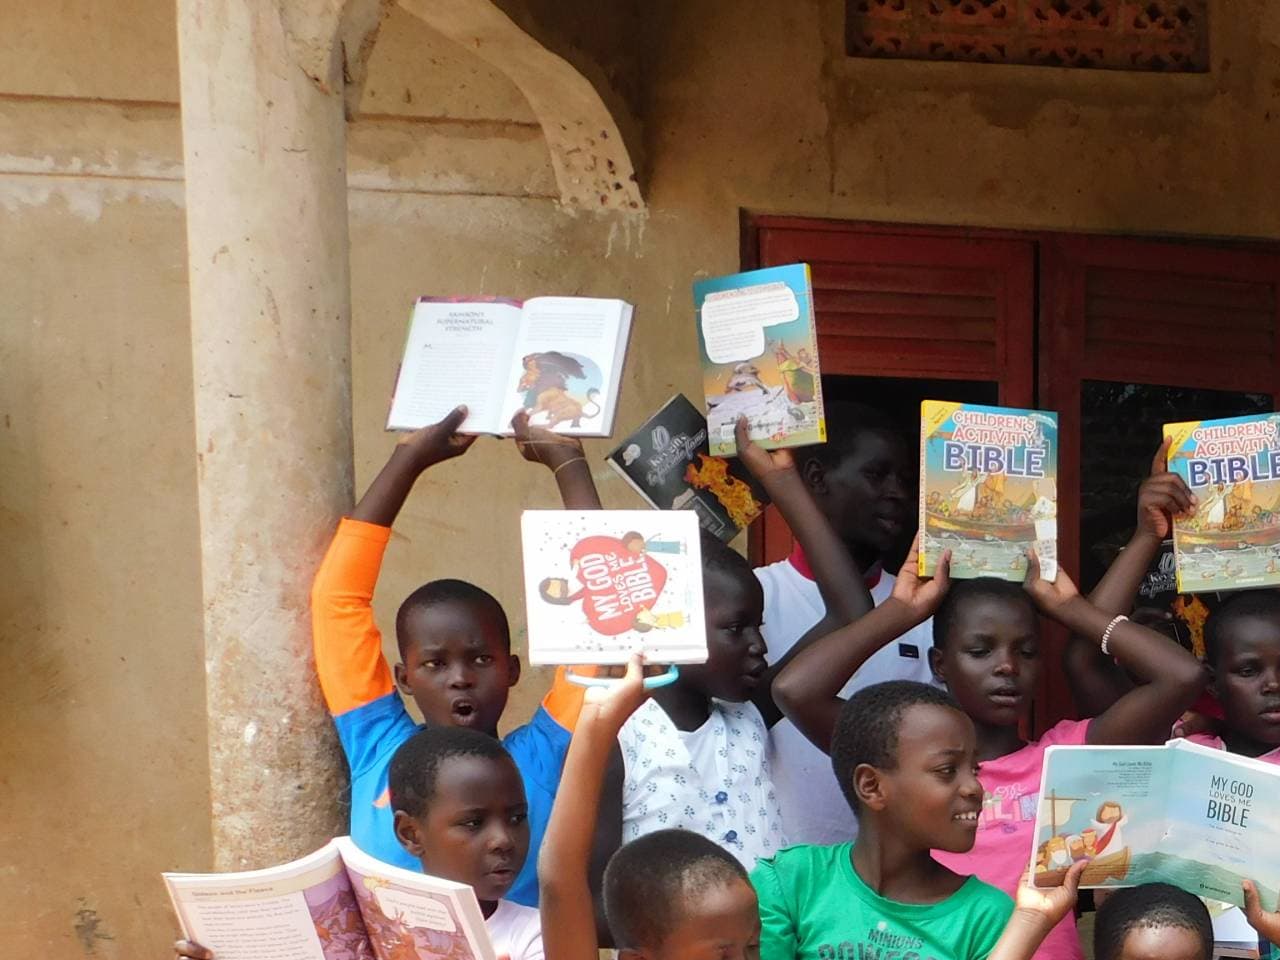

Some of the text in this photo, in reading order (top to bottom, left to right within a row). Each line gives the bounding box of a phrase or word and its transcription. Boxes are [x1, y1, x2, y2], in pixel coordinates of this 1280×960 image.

[952, 410, 1036, 432] CHILDREN'S
[1192, 421, 1276, 442] CHILDREN'S
[952, 425, 1034, 447] ACTIVITY
[1194, 434, 1276, 459] ACTIVITY
[944, 441, 1046, 478] BIBLE
[580, 553, 623, 621] MY GOD
[604, 551, 635, 613] LOVES ME
[618, 549, 657, 604] BIBLE
[1209, 790, 1252, 807] LOVES ME
[1211, 775, 1254, 799] MY GOD
[1207, 799, 1250, 828] BIBLE
